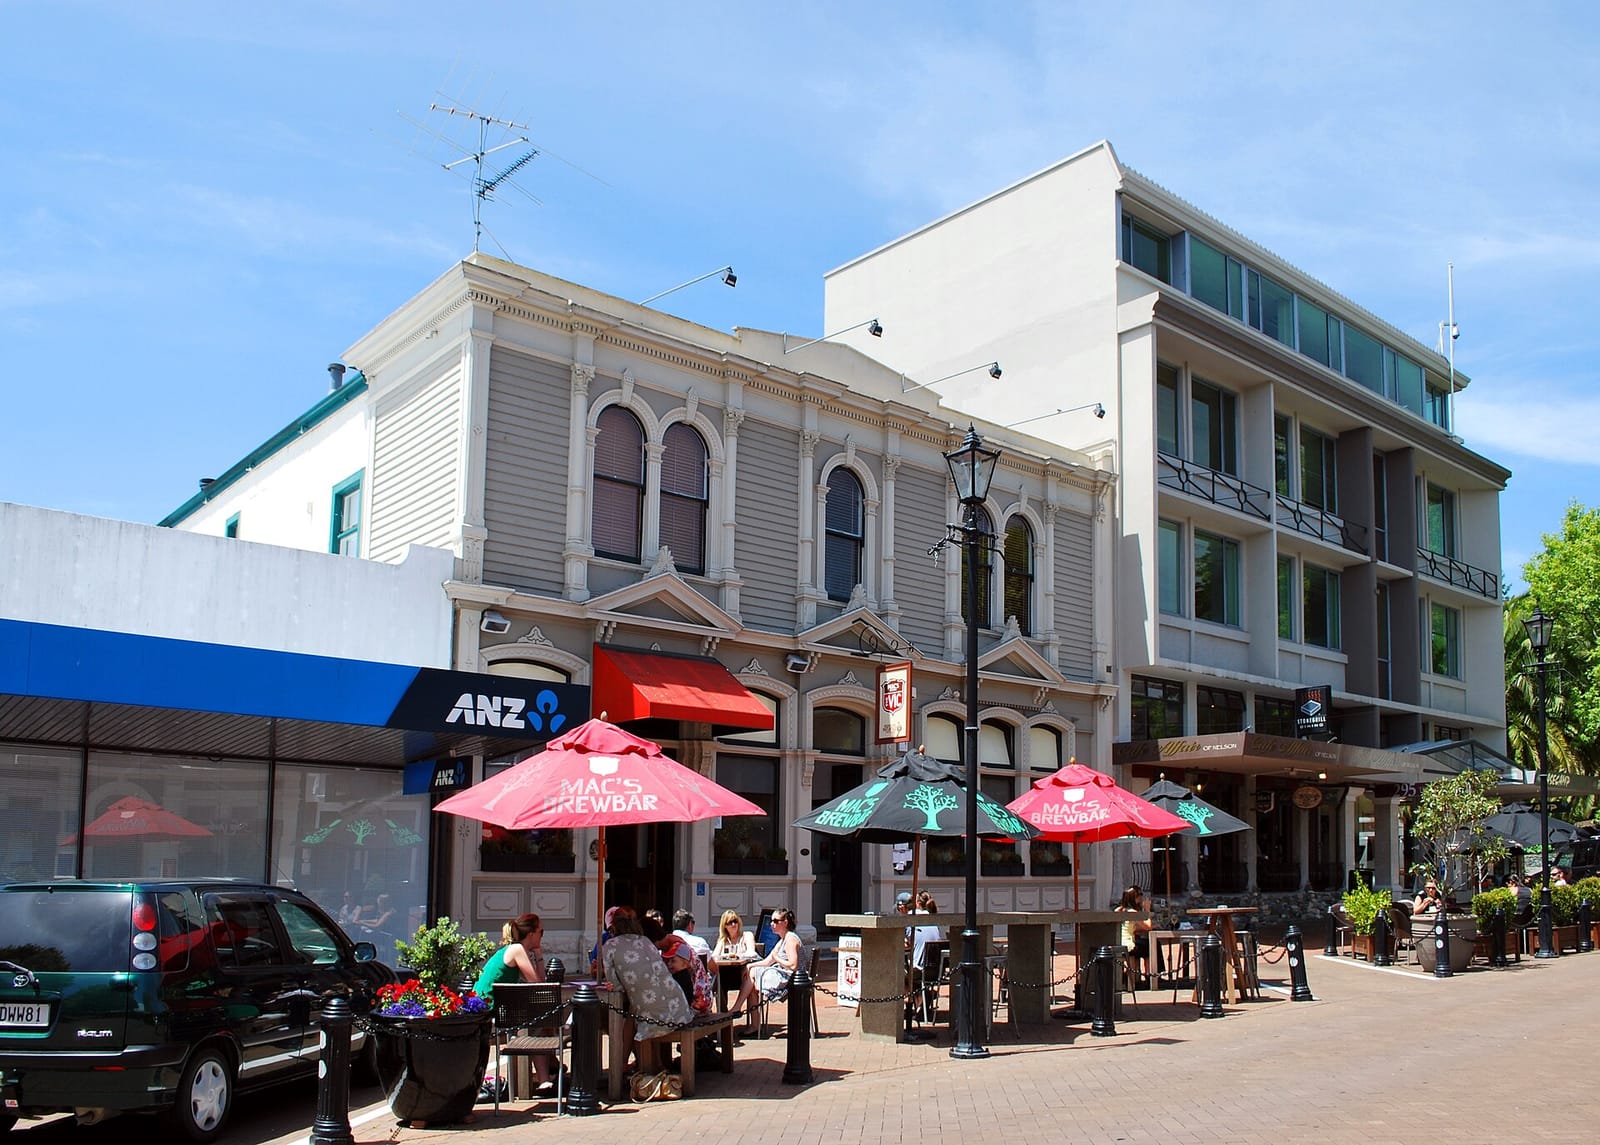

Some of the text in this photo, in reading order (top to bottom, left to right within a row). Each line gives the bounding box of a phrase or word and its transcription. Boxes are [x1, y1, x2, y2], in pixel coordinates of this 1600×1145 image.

[888, 693, 902, 708] VIC
[445, 693, 525, 729] ANZ
[1213, 743, 1237, 751] NELSON
[435, 769, 454, 786] ANZ
[560, 777, 643, 795] MAC'S
[543, 794, 659, 815] BREWBAR
[1043, 800, 1100, 815] MAC'S
